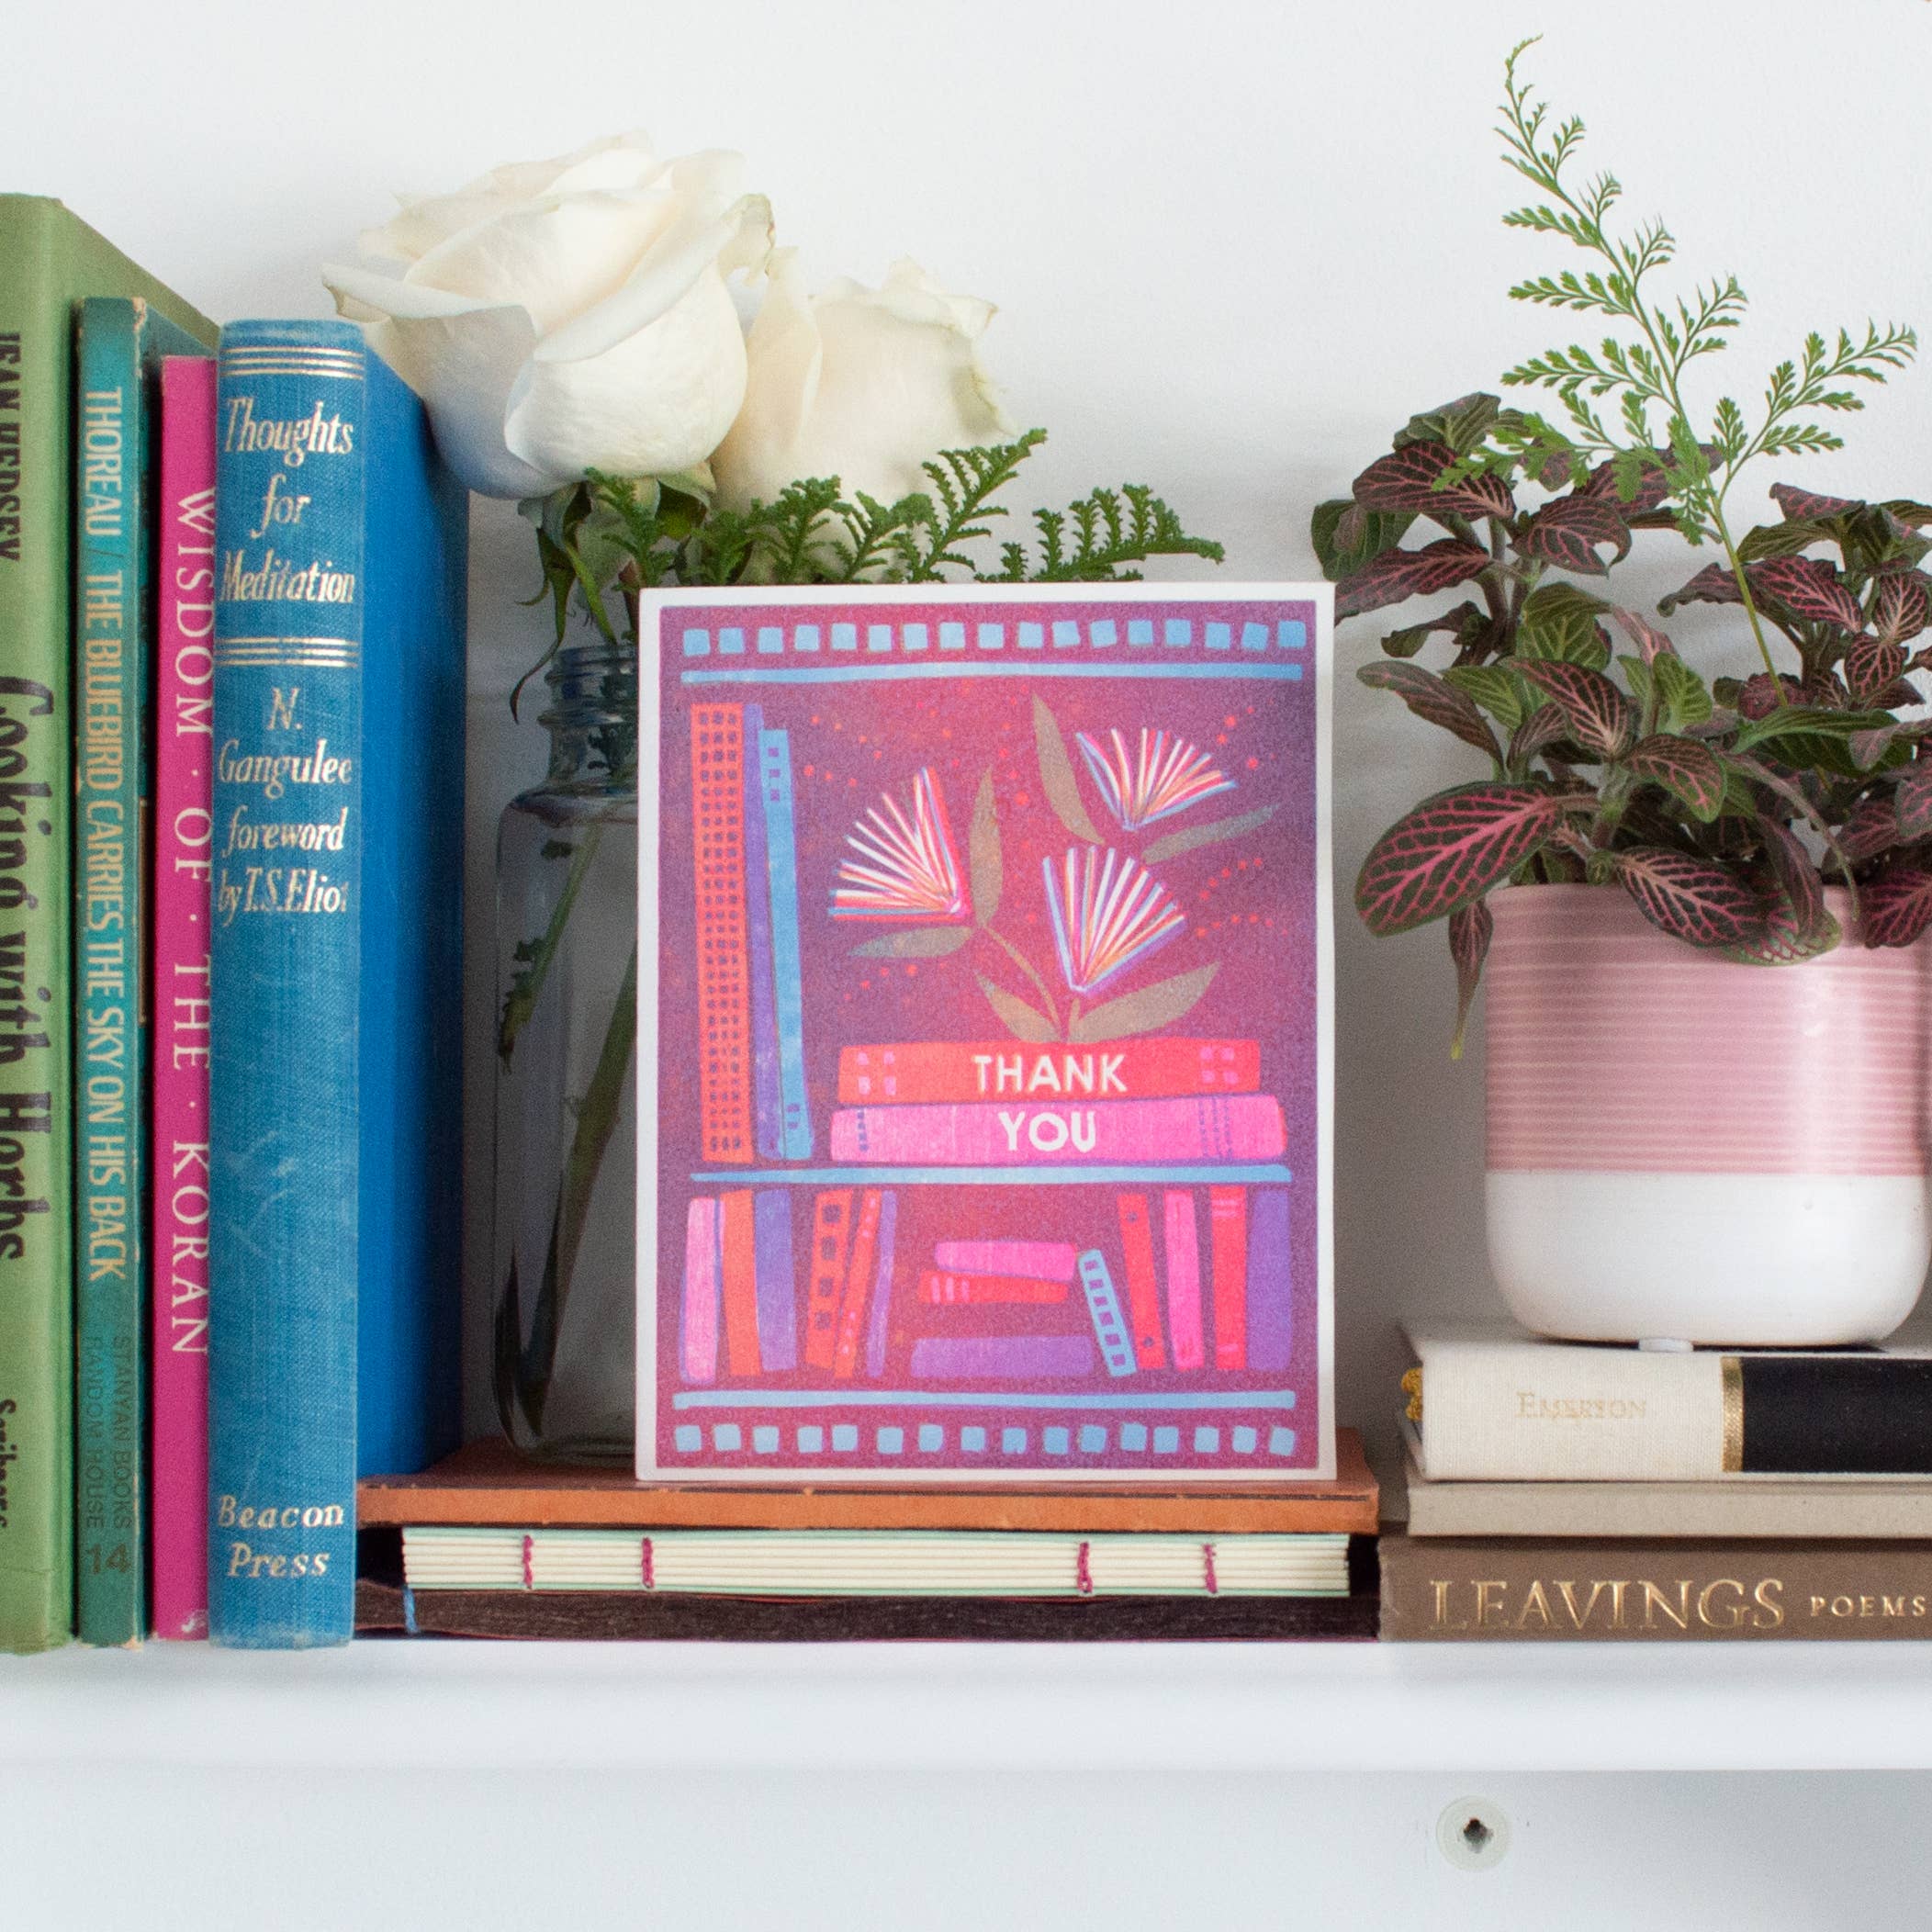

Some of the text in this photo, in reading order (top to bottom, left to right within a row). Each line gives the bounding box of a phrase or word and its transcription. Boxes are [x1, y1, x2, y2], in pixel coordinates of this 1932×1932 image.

[84, 387, 123, 535] THOREAU
[225, 397, 354, 467] Thoughts
[251, 474, 310, 539] for
[85, 570, 123, 629] THE
[220, 550, 354, 603] Meditation
[85, 640, 124, 792] BLUEBIRD
[267, 688, 301, 731] N.
[219, 738, 353, 799] Gangulee
[221, 806, 348, 858] foreword
[86, 801, 125, 931] CARRIES
[172, 487, 216, 1353] WISDOM OF THE KORAN
[218, 868, 242, 927] by
[86, 938, 126, 996] THE
[87, 1005, 127, 1071] SKY
[87, 1077, 127, 1124] ON
[973, 1053, 1129, 1094] THANK
[88, 1134, 127, 1186] HIS
[999, 1110, 1097, 1153] YOU
[88, 1196, 128, 1280] BACK
[85, 1336, 104, 1528] RANDOM HOUSE
[113, 1335, 133, 1529] STANYAN BOOKS
[218, 1495, 344, 1529] Beacon
[86, 1543, 132, 1575] 14
[227, 1543, 331, 1578] Press
[1429, 1578, 1926, 1631] LEAVINGS POEMS
